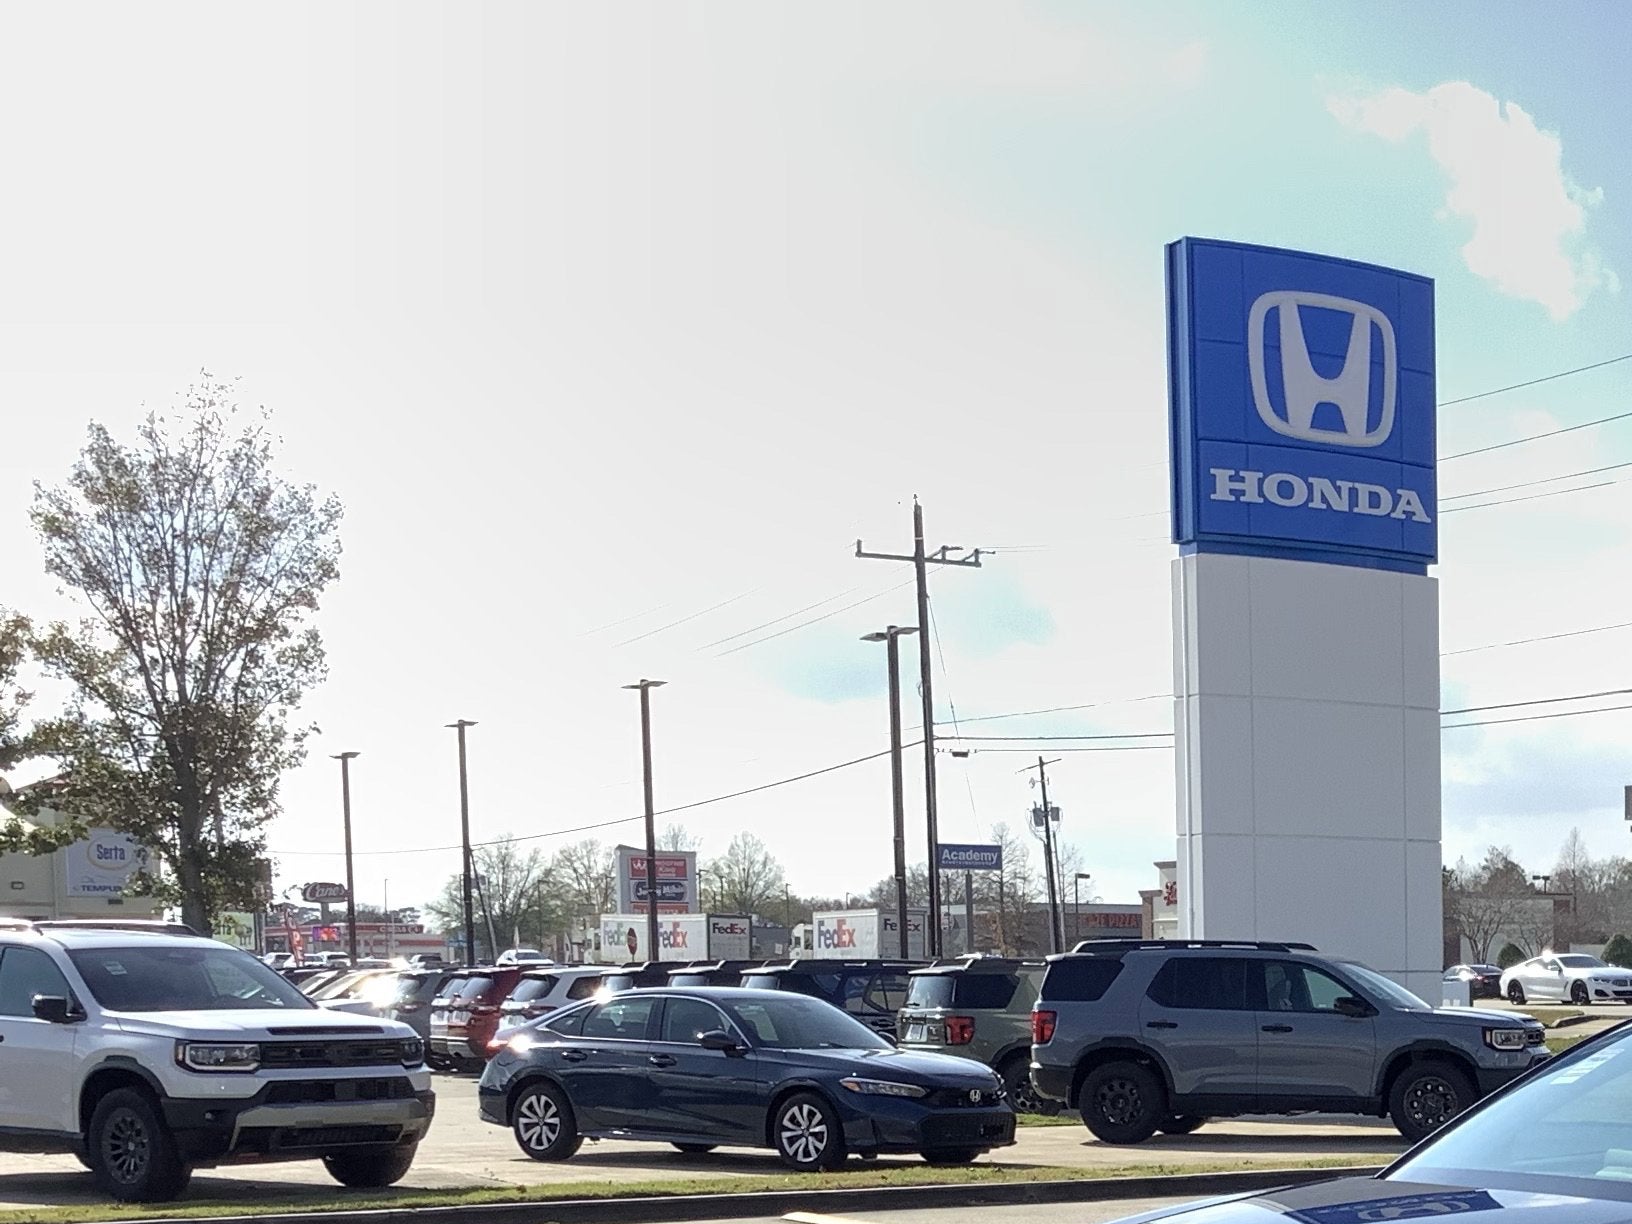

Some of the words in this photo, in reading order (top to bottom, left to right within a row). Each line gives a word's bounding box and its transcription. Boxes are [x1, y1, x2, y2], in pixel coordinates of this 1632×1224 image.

[1210, 468, 1432, 524] HONDA
[96, 844, 125, 860] Serta
[941, 849, 998, 864] Academy
[603, 922, 627, 946] FedE
[658, 921, 688, 948] FedEx
[712, 922, 747, 935] FedEx
[817, 918, 857, 949] FedEx
[883, 918, 921, 932] FeEx
